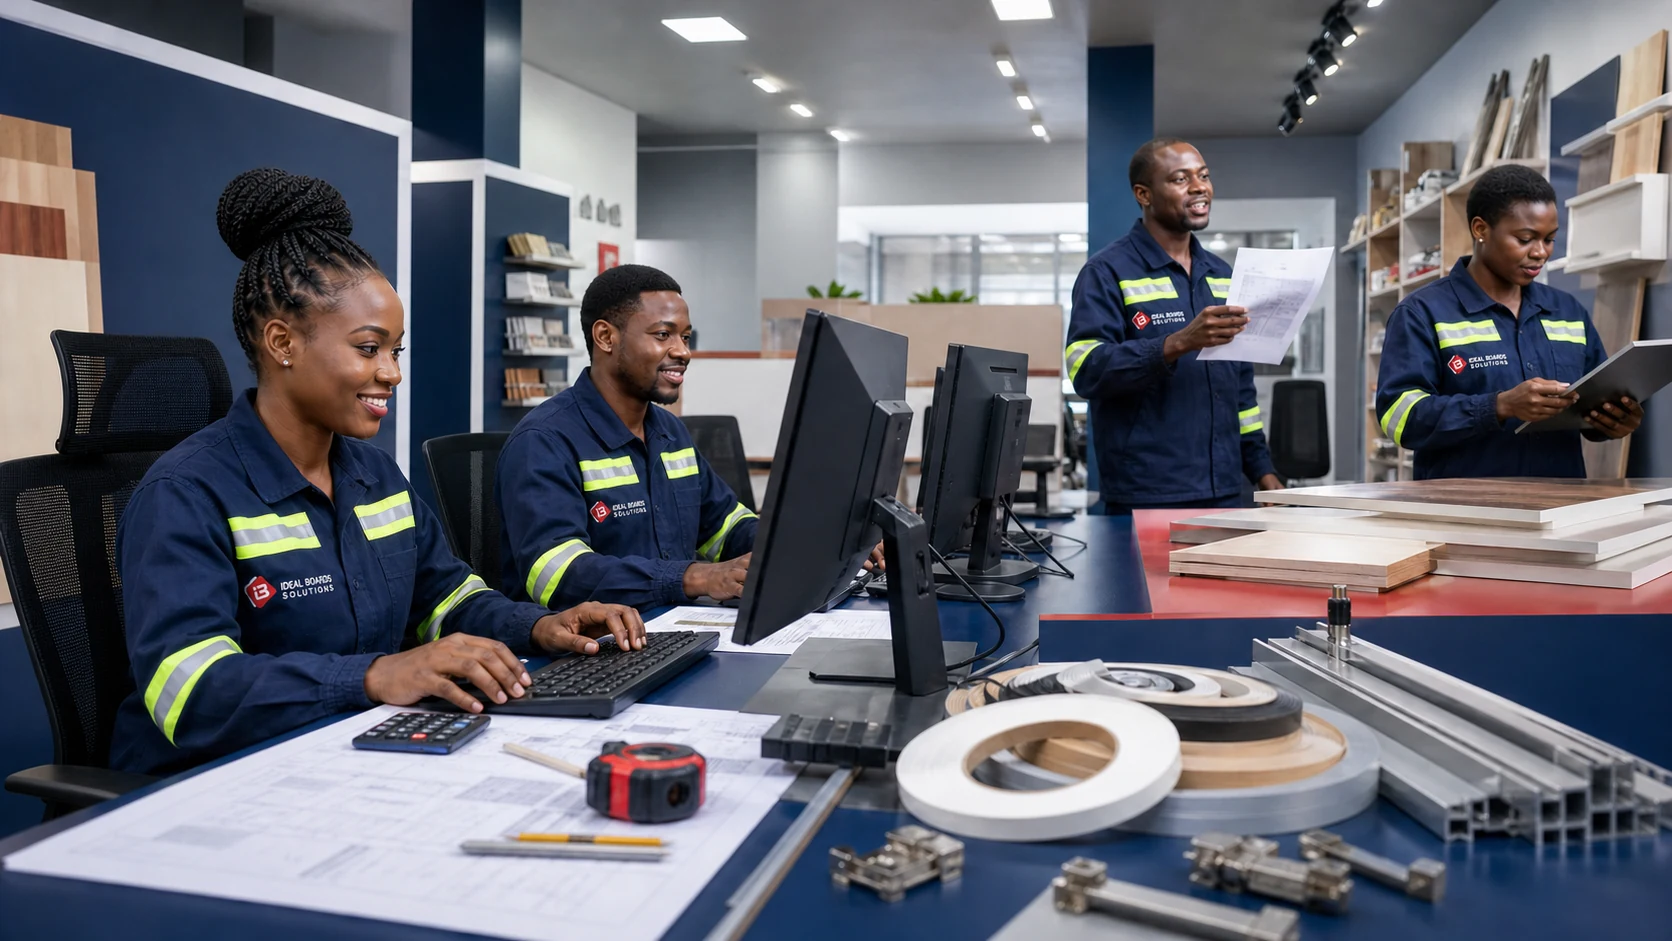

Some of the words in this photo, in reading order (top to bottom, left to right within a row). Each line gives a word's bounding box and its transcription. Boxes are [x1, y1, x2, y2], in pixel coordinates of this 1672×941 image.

[280, 579, 304, 591] IDEAL
[304, 574, 333, 587] BOARDS
[282, 584, 335, 600] SOLUTIONS
